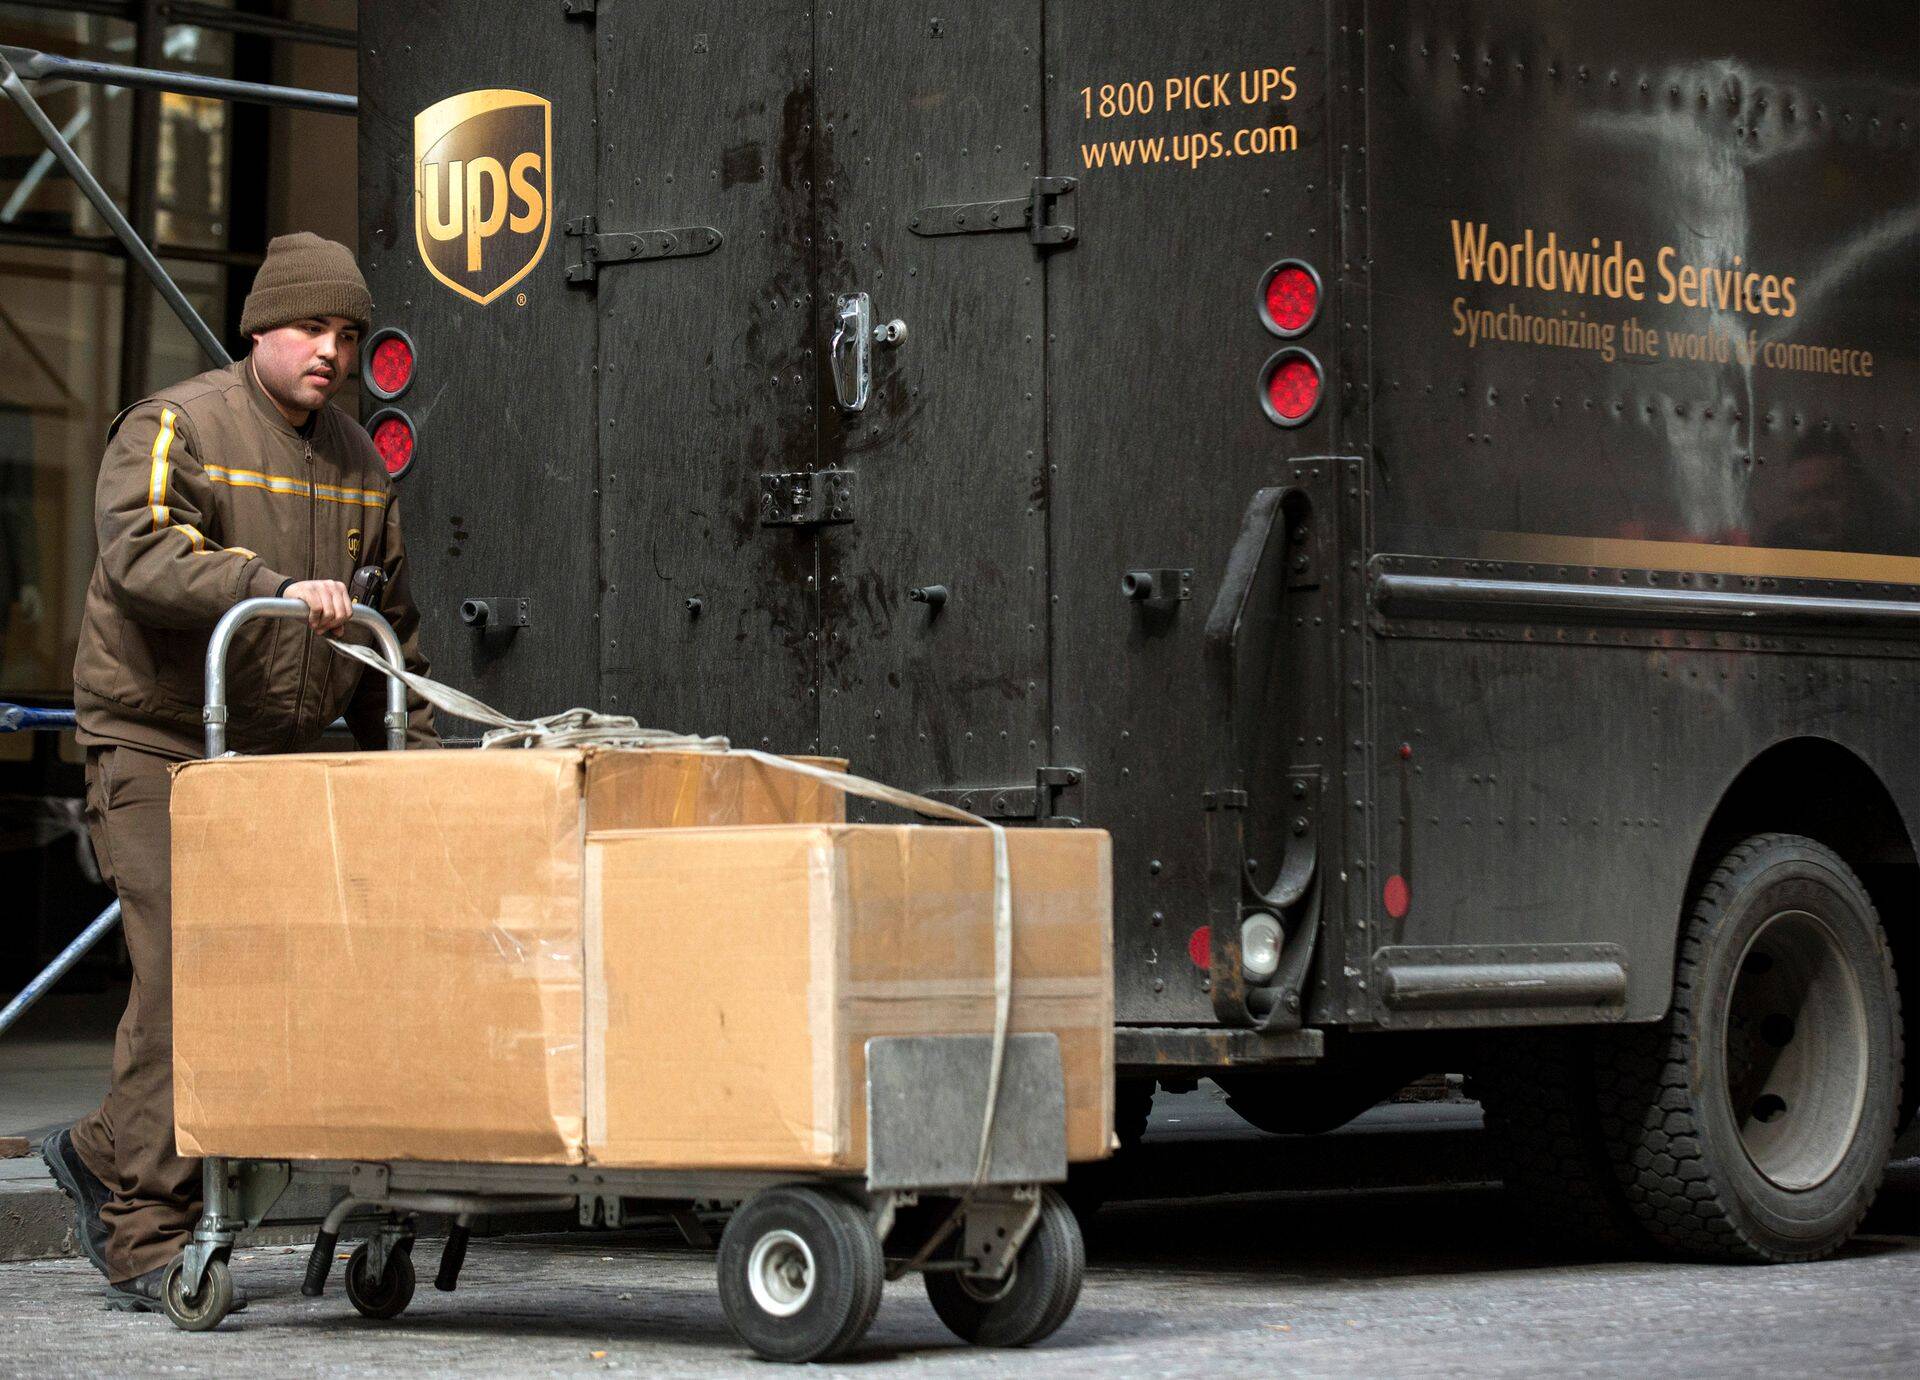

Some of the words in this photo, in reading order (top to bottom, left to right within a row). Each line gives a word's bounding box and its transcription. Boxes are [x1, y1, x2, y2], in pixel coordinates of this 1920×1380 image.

[1081, 81, 1154, 119] 1800
[1165, 72, 1231, 111] PICK
[1240, 66, 1297, 104] UPS
[1081, 124, 1298, 169] www.ups.com
[425, 152, 543, 272] ups
[1451, 219, 1645, 300] Worldwide
[1657, 246, 1797, 318] Services
[1452, 297, 1616, 362] Synchronizing
[1623, 317, 1659, 356] the
[1666, 320, 1729, 364] world
[1735, 328, 1758, 367] of
[1763, 340, 1874, 378] commerce
